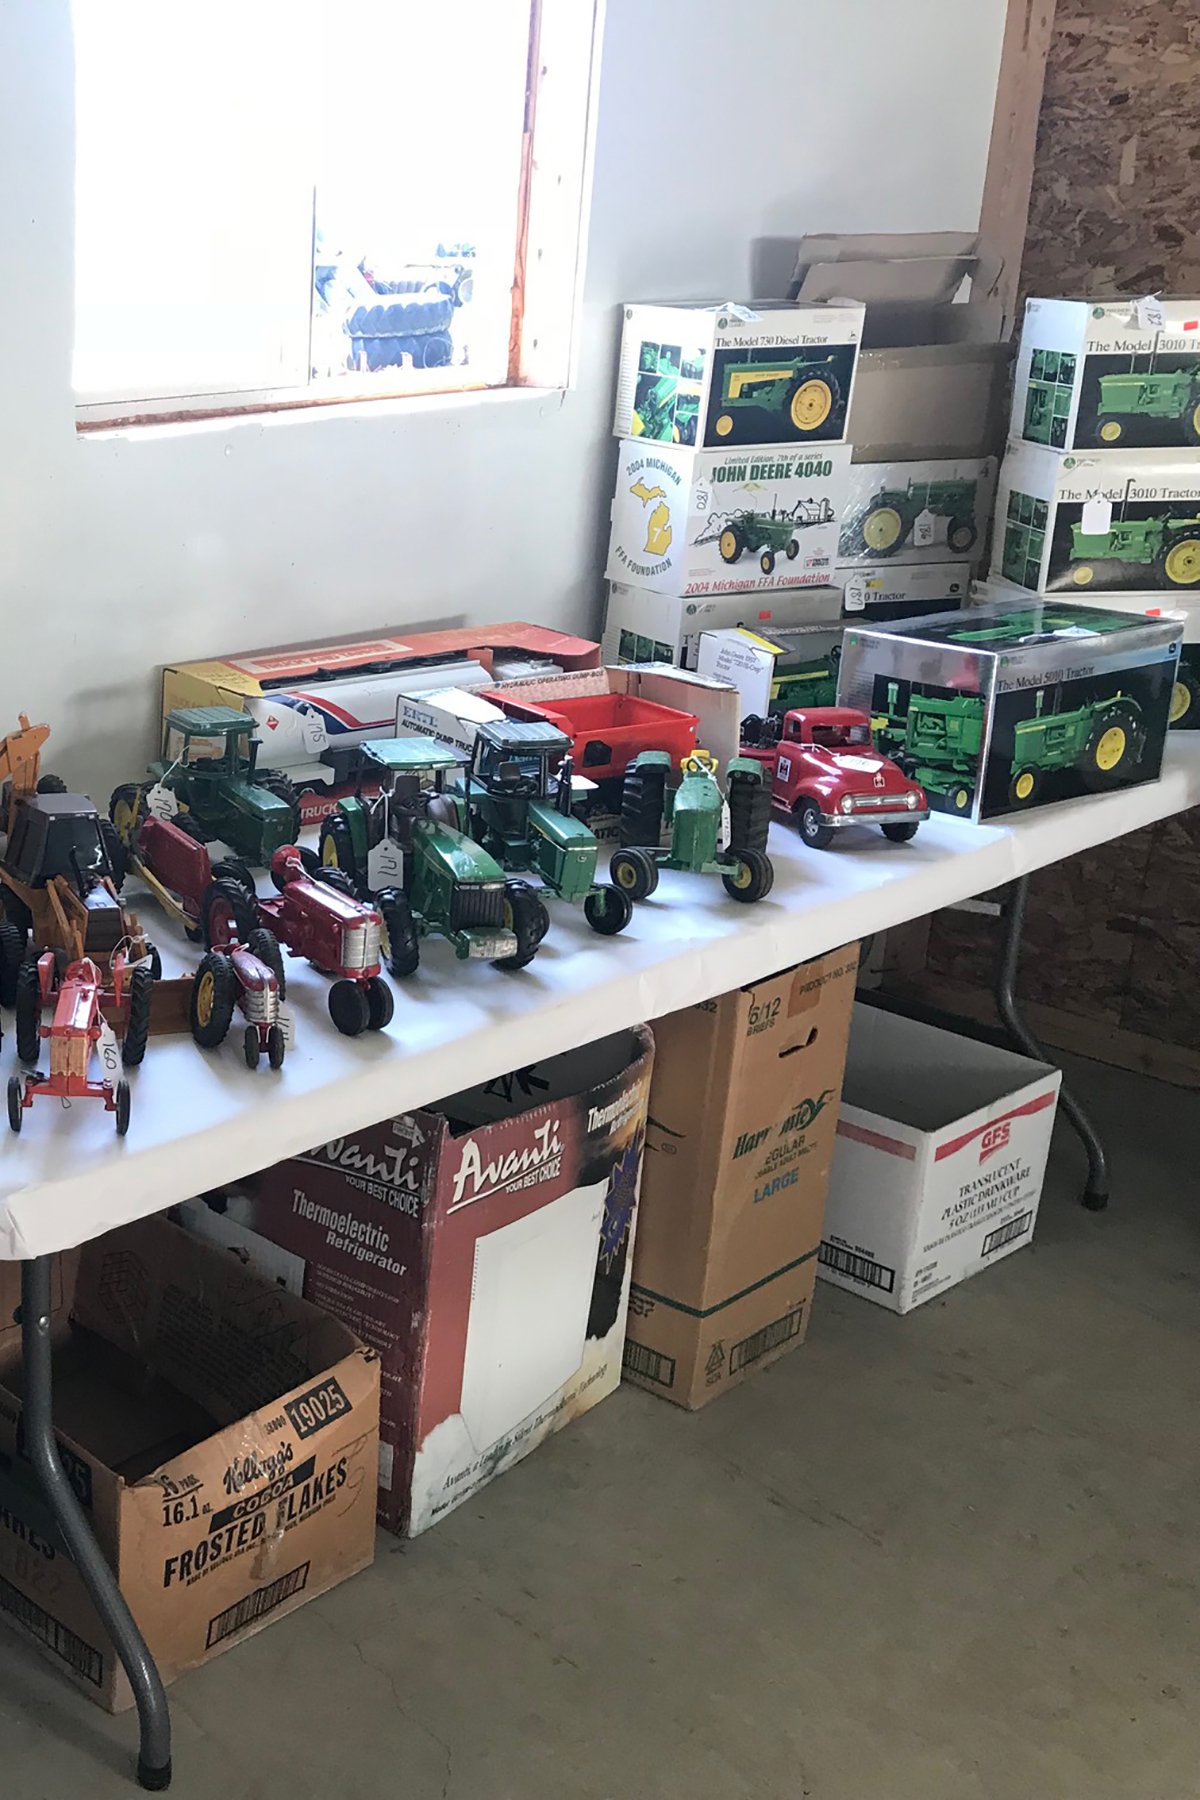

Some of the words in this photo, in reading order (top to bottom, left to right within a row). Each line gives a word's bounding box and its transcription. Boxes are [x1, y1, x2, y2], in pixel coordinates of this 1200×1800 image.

[715, 337, 732, 347] The
[733, 335, 759, 347] Model
[760, 336, 774, 345] 730
[775, 334, 800, 345] Diesel
[801, 334, 828, 344] Tractor
[1087, 340, 1111, 351] The
[1114, 339, 1151, 351] Model
[1159, 339, 1186, 350] 3010
[626, 459, 644, 476] 2004
[646, 458, 682, 486] MICHIGAN
[711, 464, 747, 483] JOHN
[749, 462, 793, 481] DEERE
[795, 460, 833, 477] 4040
[1059, 489, 1082, 500] The
[1128, 488, 1157, 499] 3010
[627, 557, 672, 577] FOUNDATION
[685, 582, 709, 595] 2004
[712, 577, 755, 592] Michigan
[757, 575, 775, 588] FFA
[776, 571, 830, 586] Foundation
[873, 591, 906, 601] Tractor
[1016, 674, 1043, 688] Model
[1066, 666, 1095, 680] Tractor
[401, 719, 436, 738] AUTOMATIC
[454, 738, 474, 754] TRUC
[300, 802, 338, 819] TRUCK
[749, 996, 782, 1025] 6/12
[981, 1121, 1012, 1149] GFS
[310, 1138, 420, 1190] vanti
[452, 1119, 561, 1204] Avanti
[505, 1177, 524, 1194] YOUR
[523, 1171, 540, 1189] BEST
[539, 1156, 561, 1181] CHOICE
[959, 1157, 1022, 1198] TRANSLUCENT
[344, 1175, 367, 1192] YOUR
[367, 1183, 389, 1202] BEST
[388, 1190, 420, 1219] CHOICE
[753, 1166, 800, 1204] LARGE
[941, 1194, 977, 1221] PLASTIC
[977, 1166, 1032, 1203] DRINKWARE
[292, 1189, 390, 1252] Thermoelectric
[326, 1230, 407, 1276] Refrigerator
[290, 1385, 346, 1433] 19025
[223, 1441, 294, 1496] Kellogg's
[162, 1495, 200, 1527] 16.1
[232, 1474, 295, 1519] COCOA
[163, 1511, 267, 1588] FROSTED
[276, 1457, 347, 1530] FLAKES
